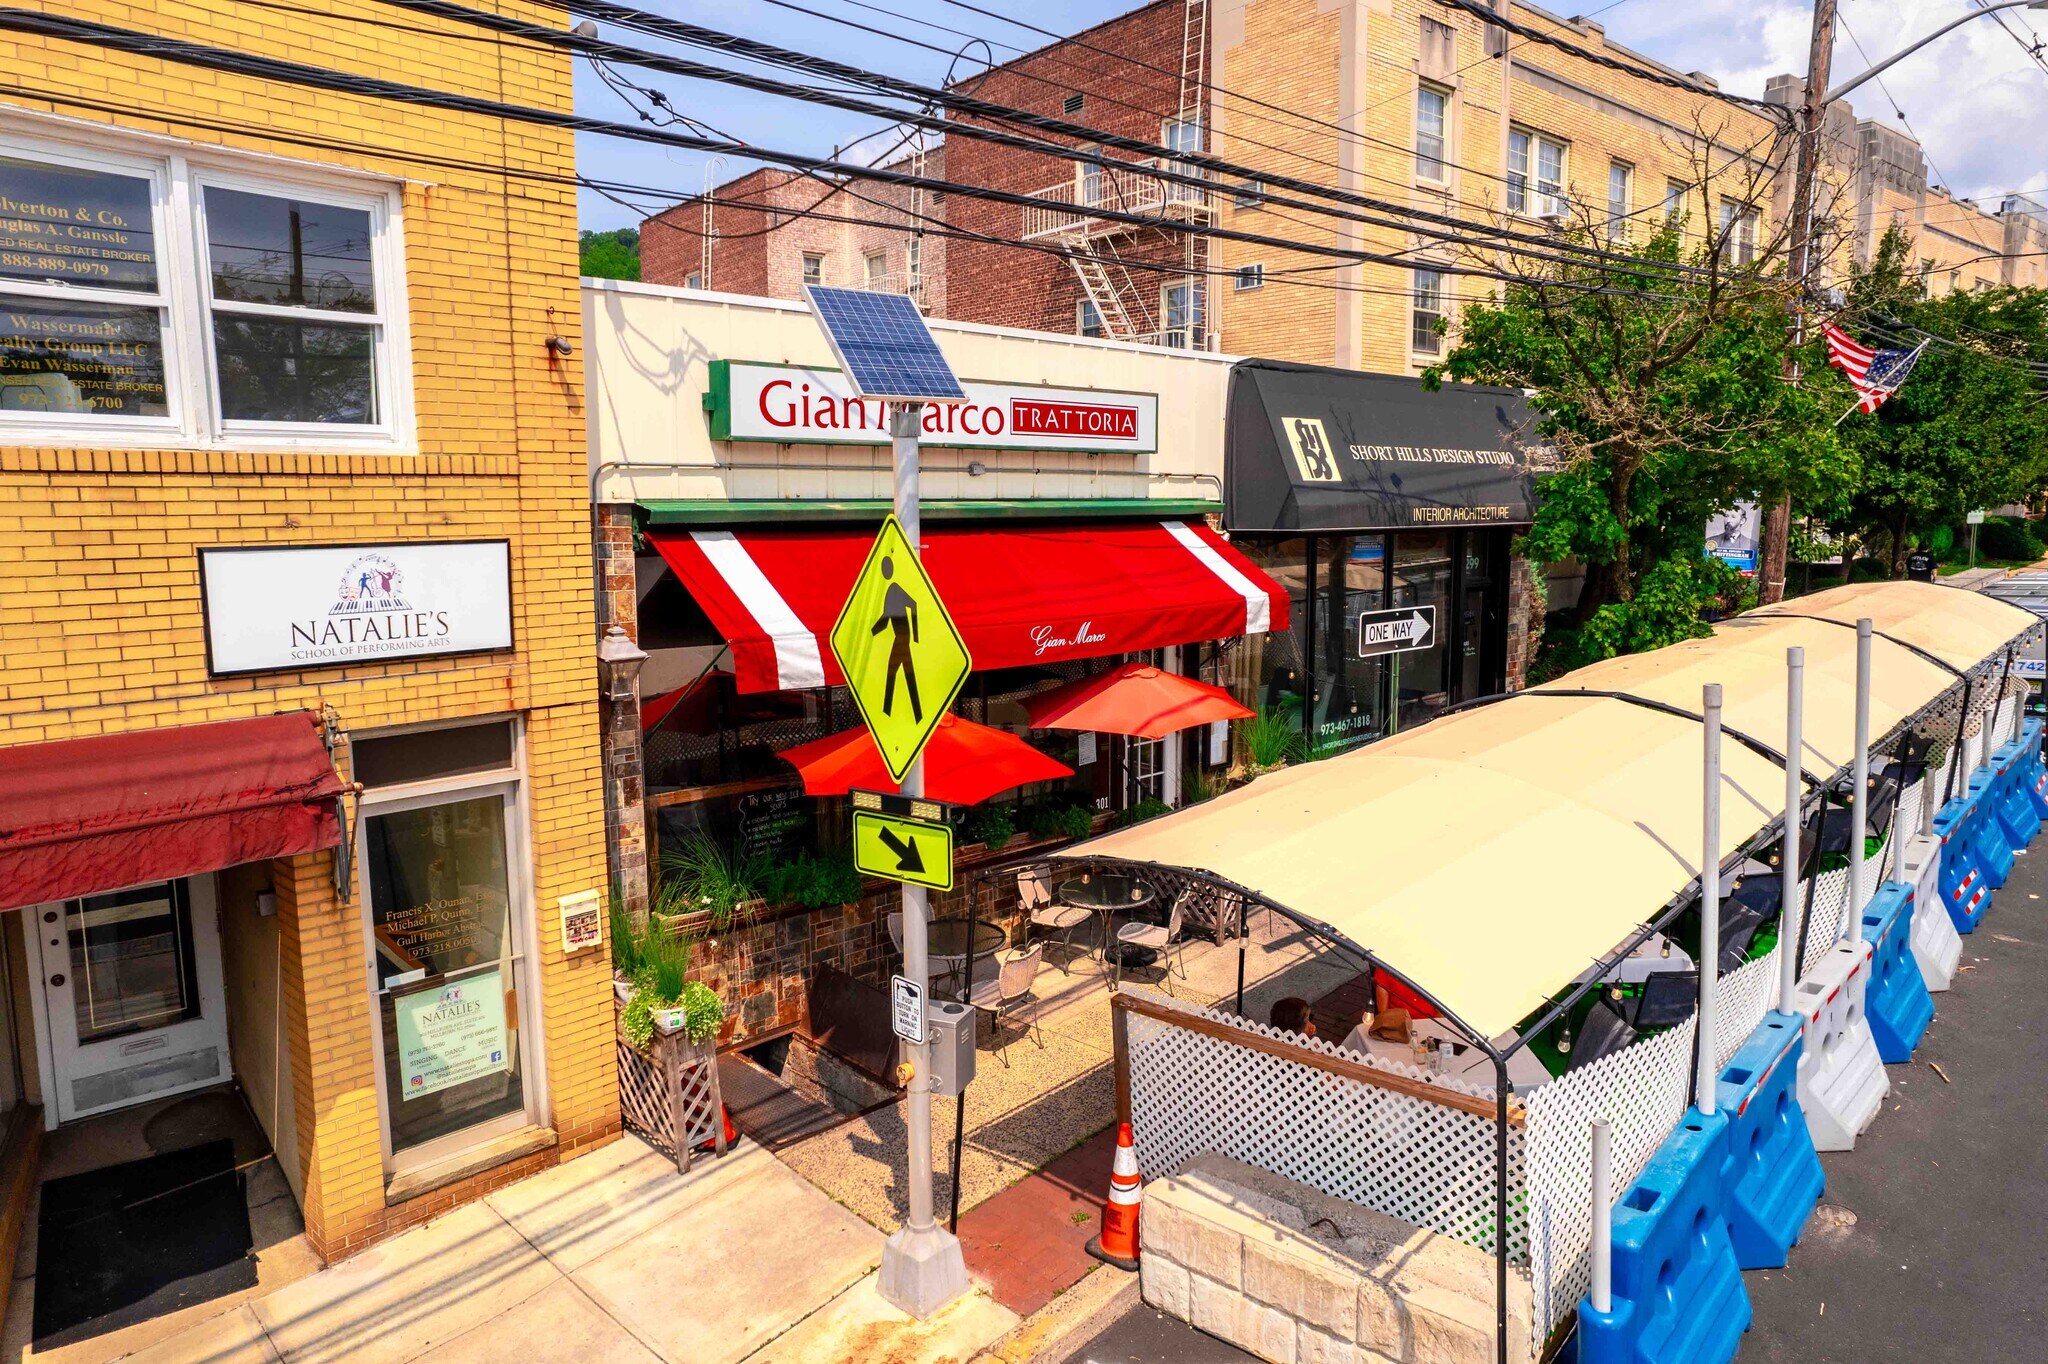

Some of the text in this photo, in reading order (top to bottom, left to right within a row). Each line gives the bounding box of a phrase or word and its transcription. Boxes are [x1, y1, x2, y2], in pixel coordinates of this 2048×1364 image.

[0, 197, 128, 227] lverton & Co.
[45, 224, 63, 236] A.
[68, 226, 128, 244] Ganssle
[18, 240, 52, 251] REAL
[55, 244, 98, 256] ESTATE
[102, 250, 151, 262] BROKER
[10, 314, 117, 337] Wasserman
[44, 337, 102, 356] Group
[108, 342, 148, 357] LLC
[0, 355, 134, 375] Evan Wasserman
[71, 379, 112, 390] ESTATE
[116, 381, 163, 392] BROKER
[759, 379, 1135, 436] Gian arco TRATTORIA
[1350, 445, 1515, 465] SHORT HILLS DESIGN STUDIO
[1413, 506, 1510, 522] INTERIOR ARCHITECTURE
[291, 611, 449, 648] NATALIE'S
[1030, 621, 1106, 656] Gian Marco
[1369, 621, 1413, 641] ONE WAY
[291, 637, 450, 660] SCHOOL OF PERFORMING ARTS
[1320, 714, 1370, 736] 973-467-1818
[1095, 796, 1109, 809] 301
[386, 905, 422, 921] Francis
[387, 915, 427, 933] Michael
[396, 935, 418, 948] Gull
[420, 928, 450, 942] Harbor
[412, 936, 477, 957] 973.218.0050
[422, 1000, 480, 1025] NATALIE'S
[444, 1046, 466, 1057] DANCE
[478, 1036, 498, 1047] MUSIC
[409, 1054, 438, 1067] SINGING
